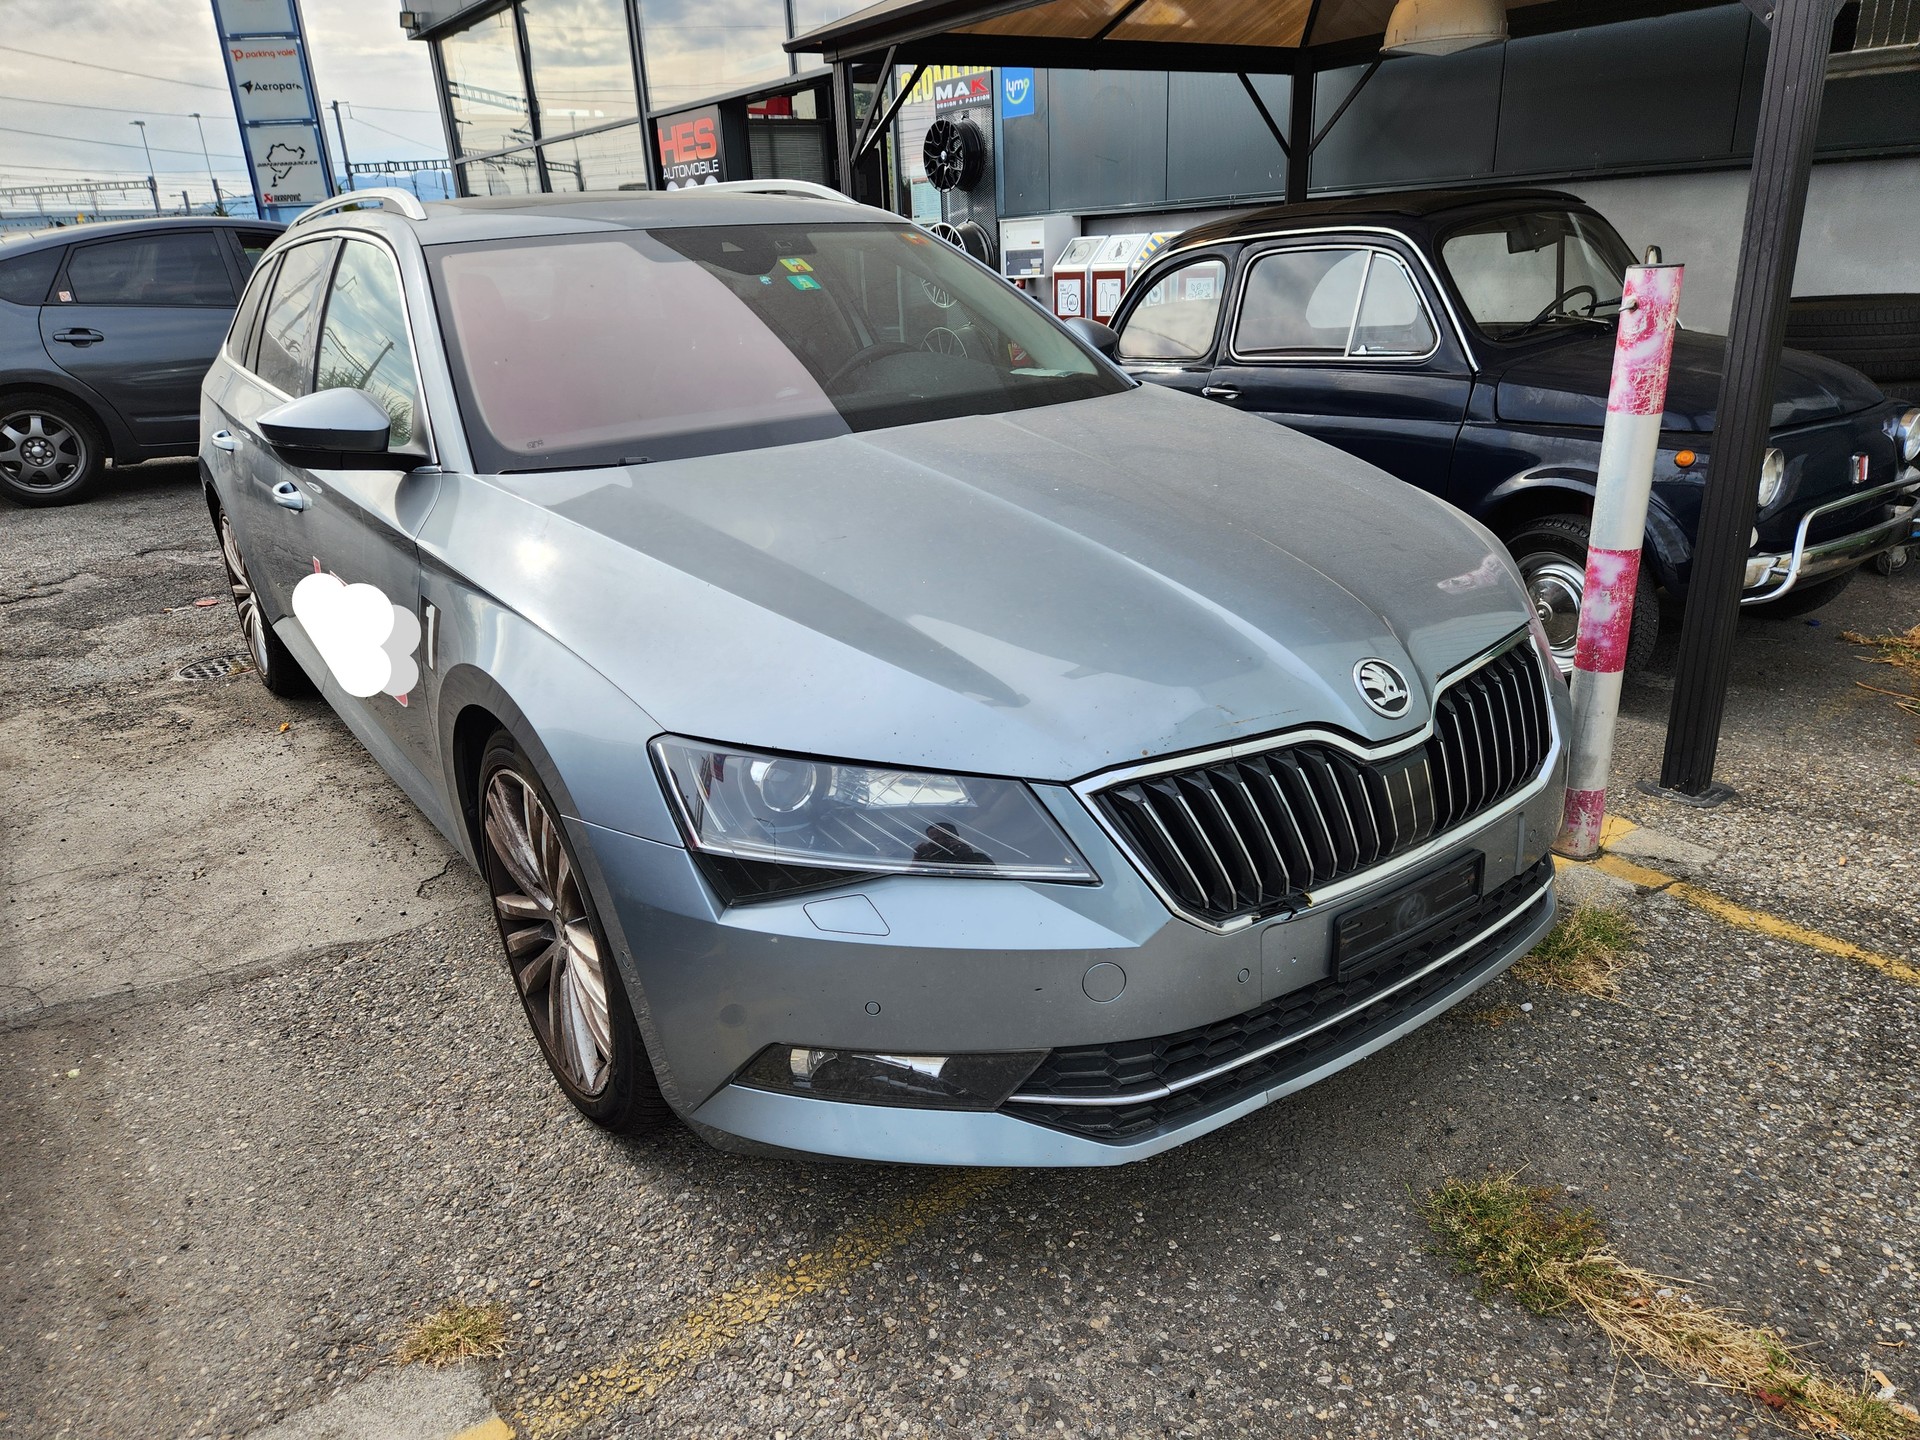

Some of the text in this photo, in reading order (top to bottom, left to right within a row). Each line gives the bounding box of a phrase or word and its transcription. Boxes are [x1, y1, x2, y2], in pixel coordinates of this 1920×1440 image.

[245, 50, 275, 59] parking
[936, 77, 989, 101] MAK
[936, 101, 957, 109] DESIGN
[965, 94, 990, 103] PASSION
[658, 117, 718, 165] HES
[663, 159, 719, 180] AUTOMOBILE
